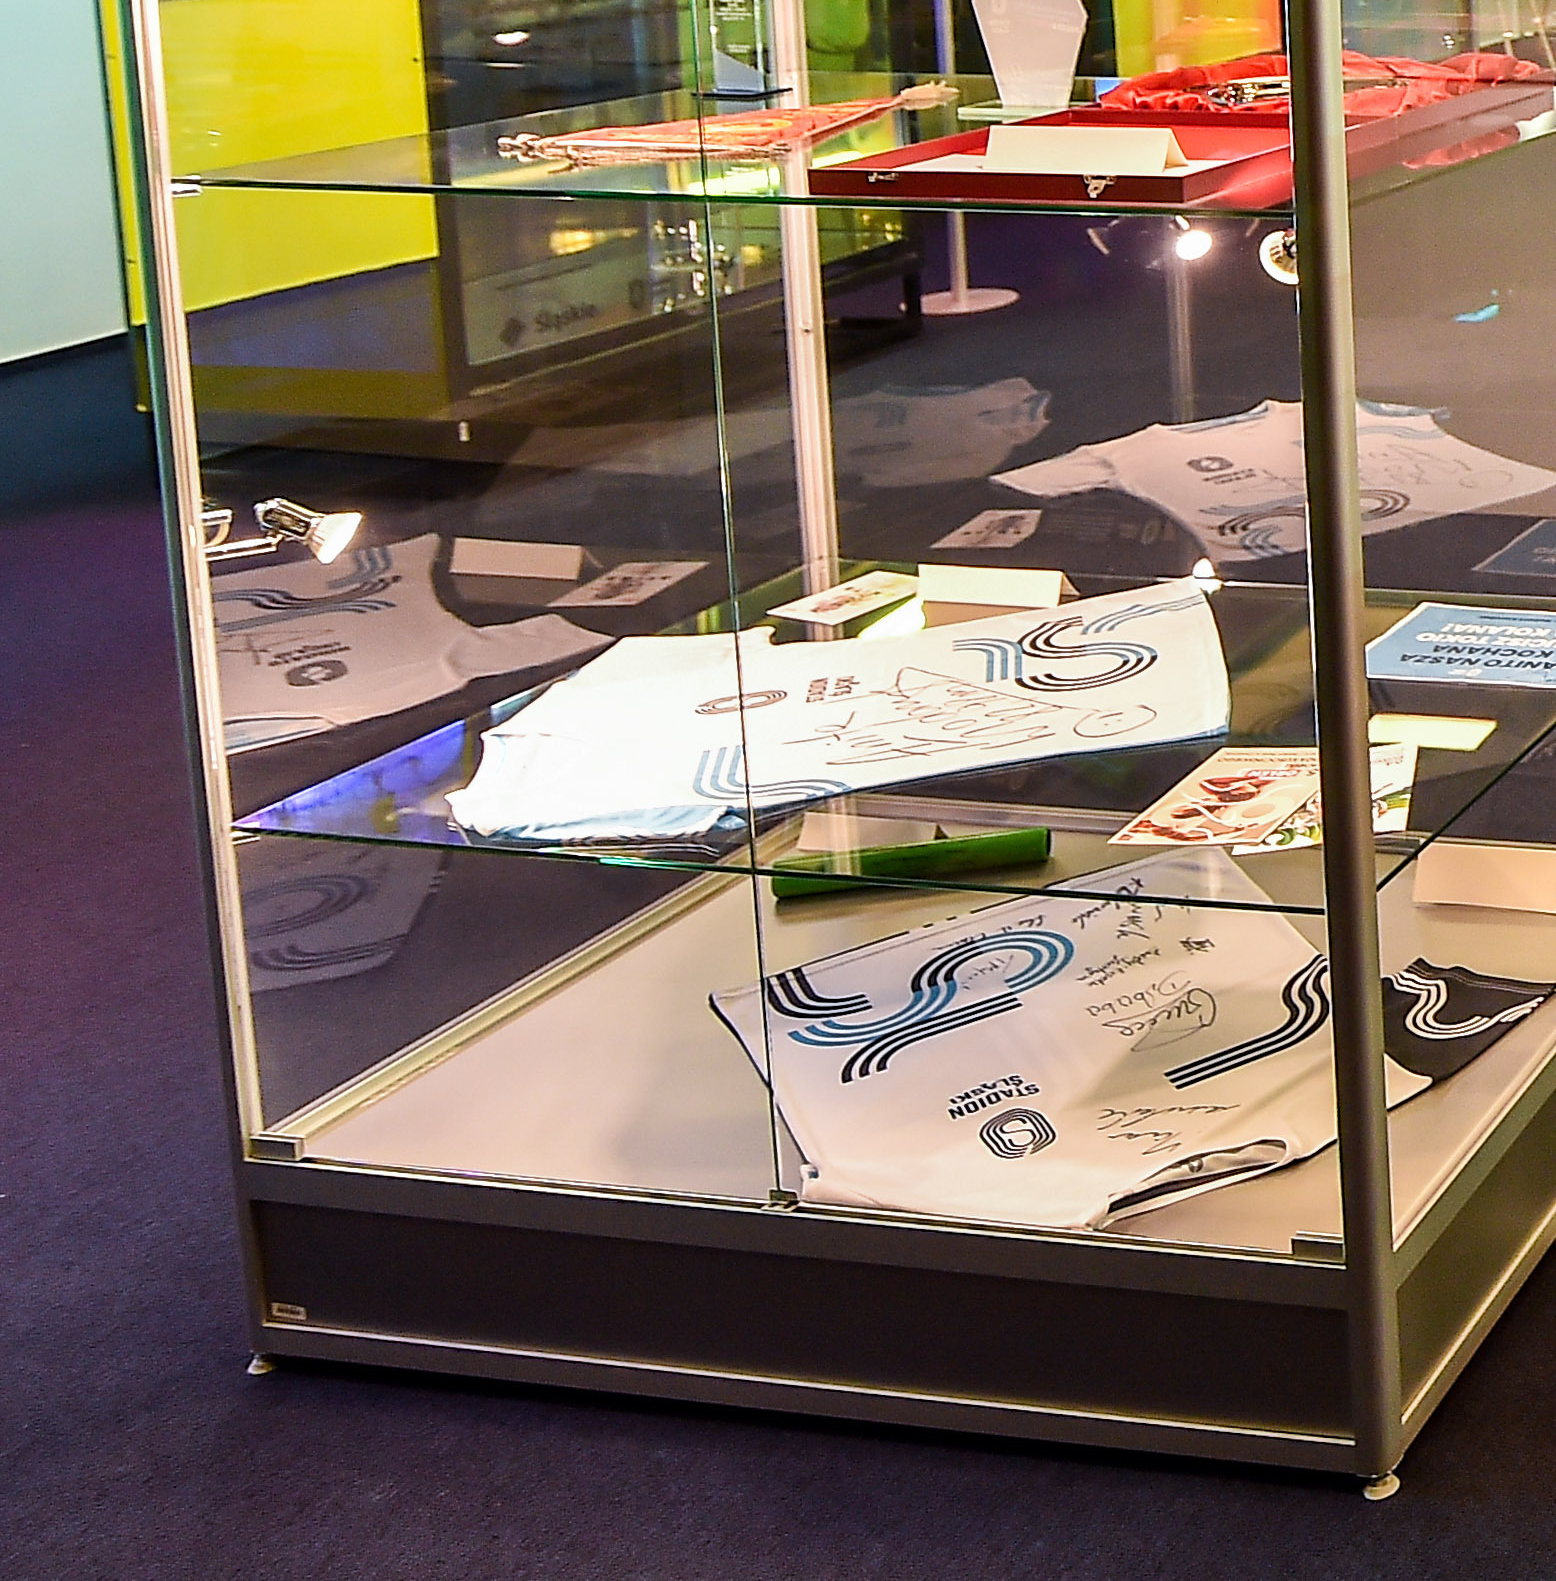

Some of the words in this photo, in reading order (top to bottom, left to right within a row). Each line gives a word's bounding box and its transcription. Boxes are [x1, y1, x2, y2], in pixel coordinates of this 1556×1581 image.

[1415, 632, 1488, 647] TOKIO
[1432, 644, 1555, 659] KOCHANA
[1399, 653, 1481, 669] NASZA
[947, 1083, 1041, 1120] STADION
